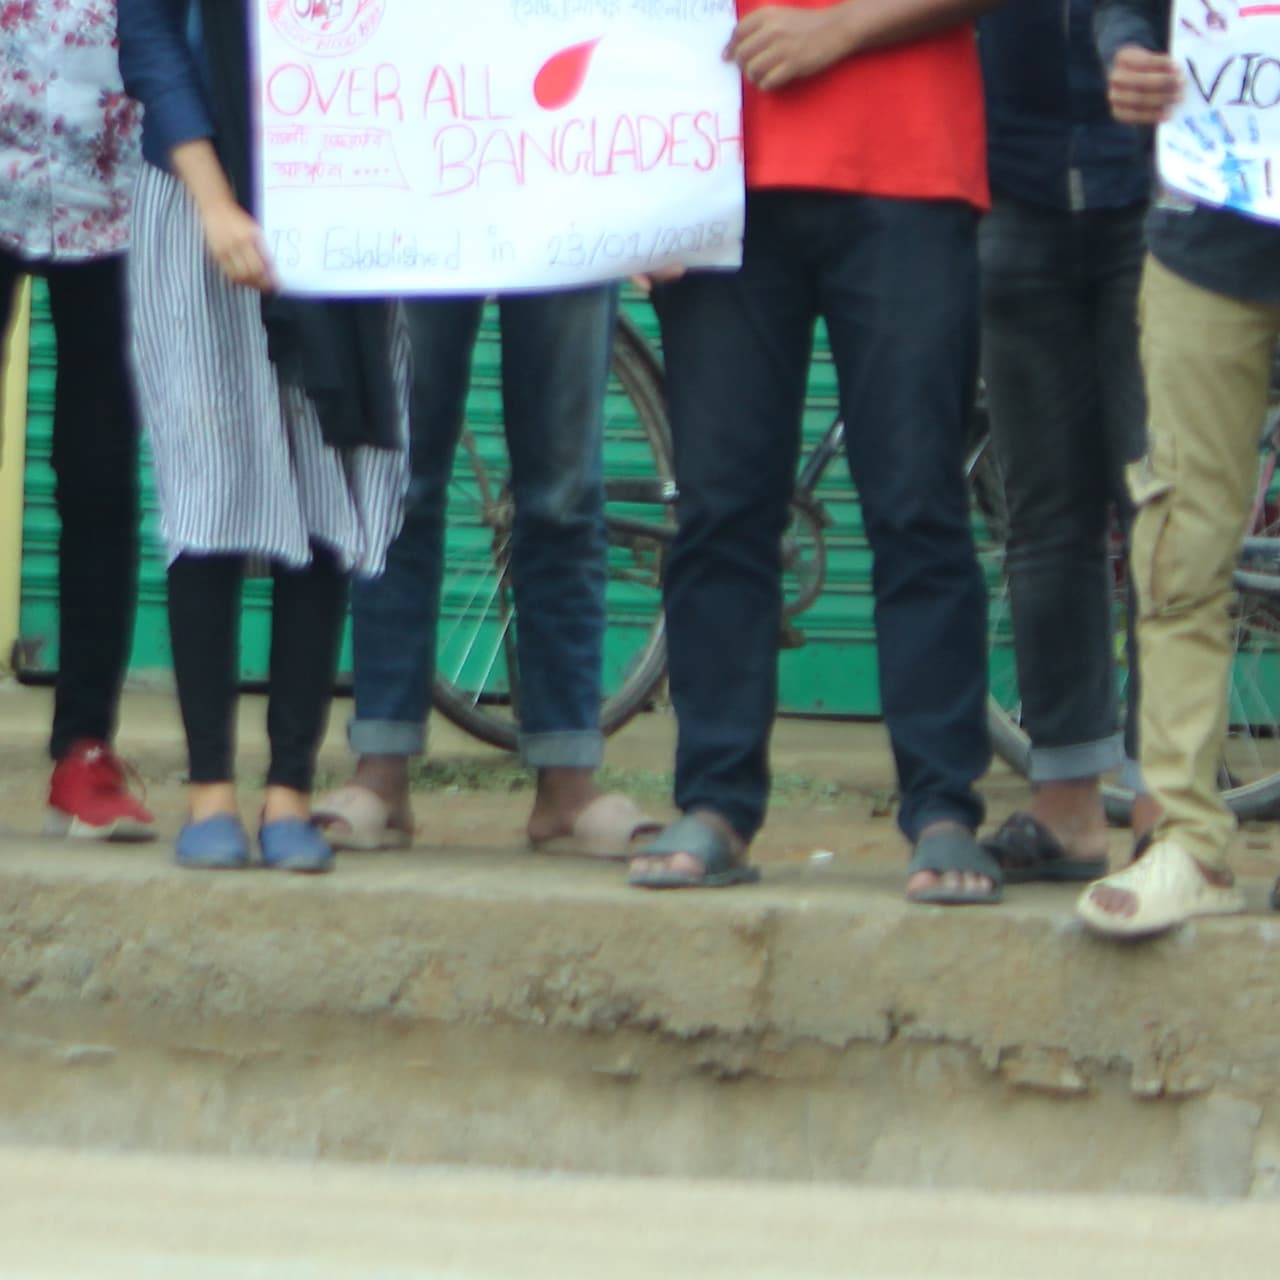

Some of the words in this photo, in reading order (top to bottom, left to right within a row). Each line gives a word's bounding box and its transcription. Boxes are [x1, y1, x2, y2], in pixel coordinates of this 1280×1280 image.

[266, 62, 404, 122] OVER
[424, 62, 512, 120] ALL
[431, 110, 744, 198] BANGLADESH
